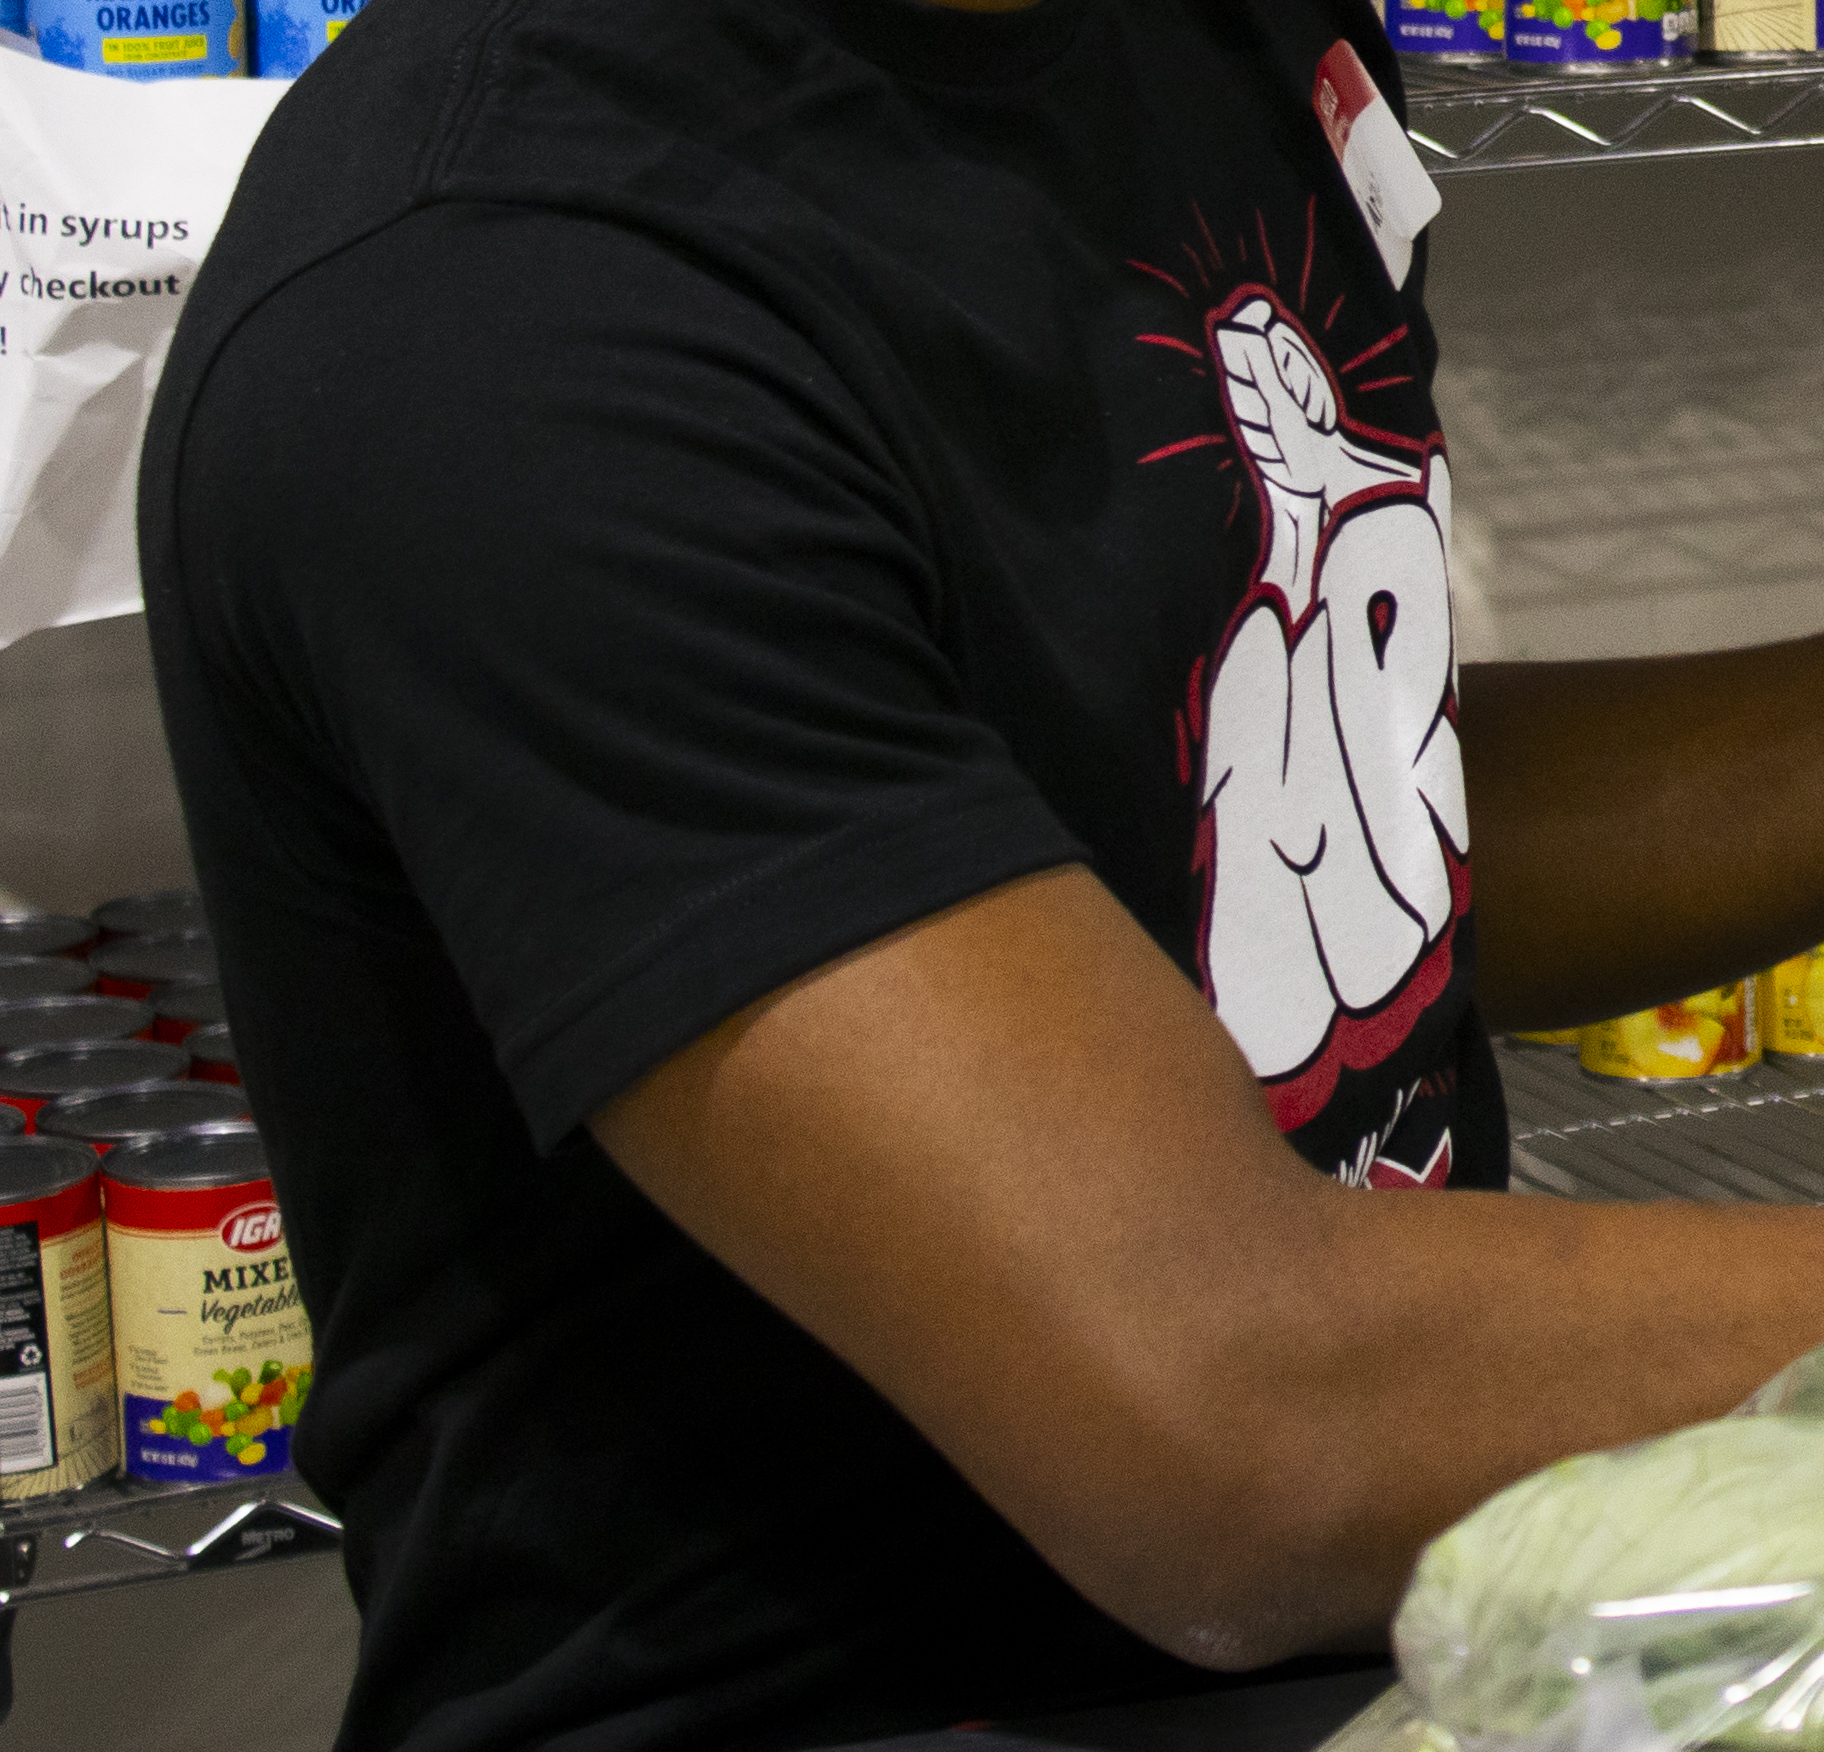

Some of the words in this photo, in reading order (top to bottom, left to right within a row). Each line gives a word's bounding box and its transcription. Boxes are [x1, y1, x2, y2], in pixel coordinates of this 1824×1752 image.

[97, 0, 210, 31] ORANGES
[19, 202, 48, 235] in
[61, 214, 190, 249] syrups
[20, 266, 181, 300] checkout
[203, 1257, 292, 1294] MIXE
